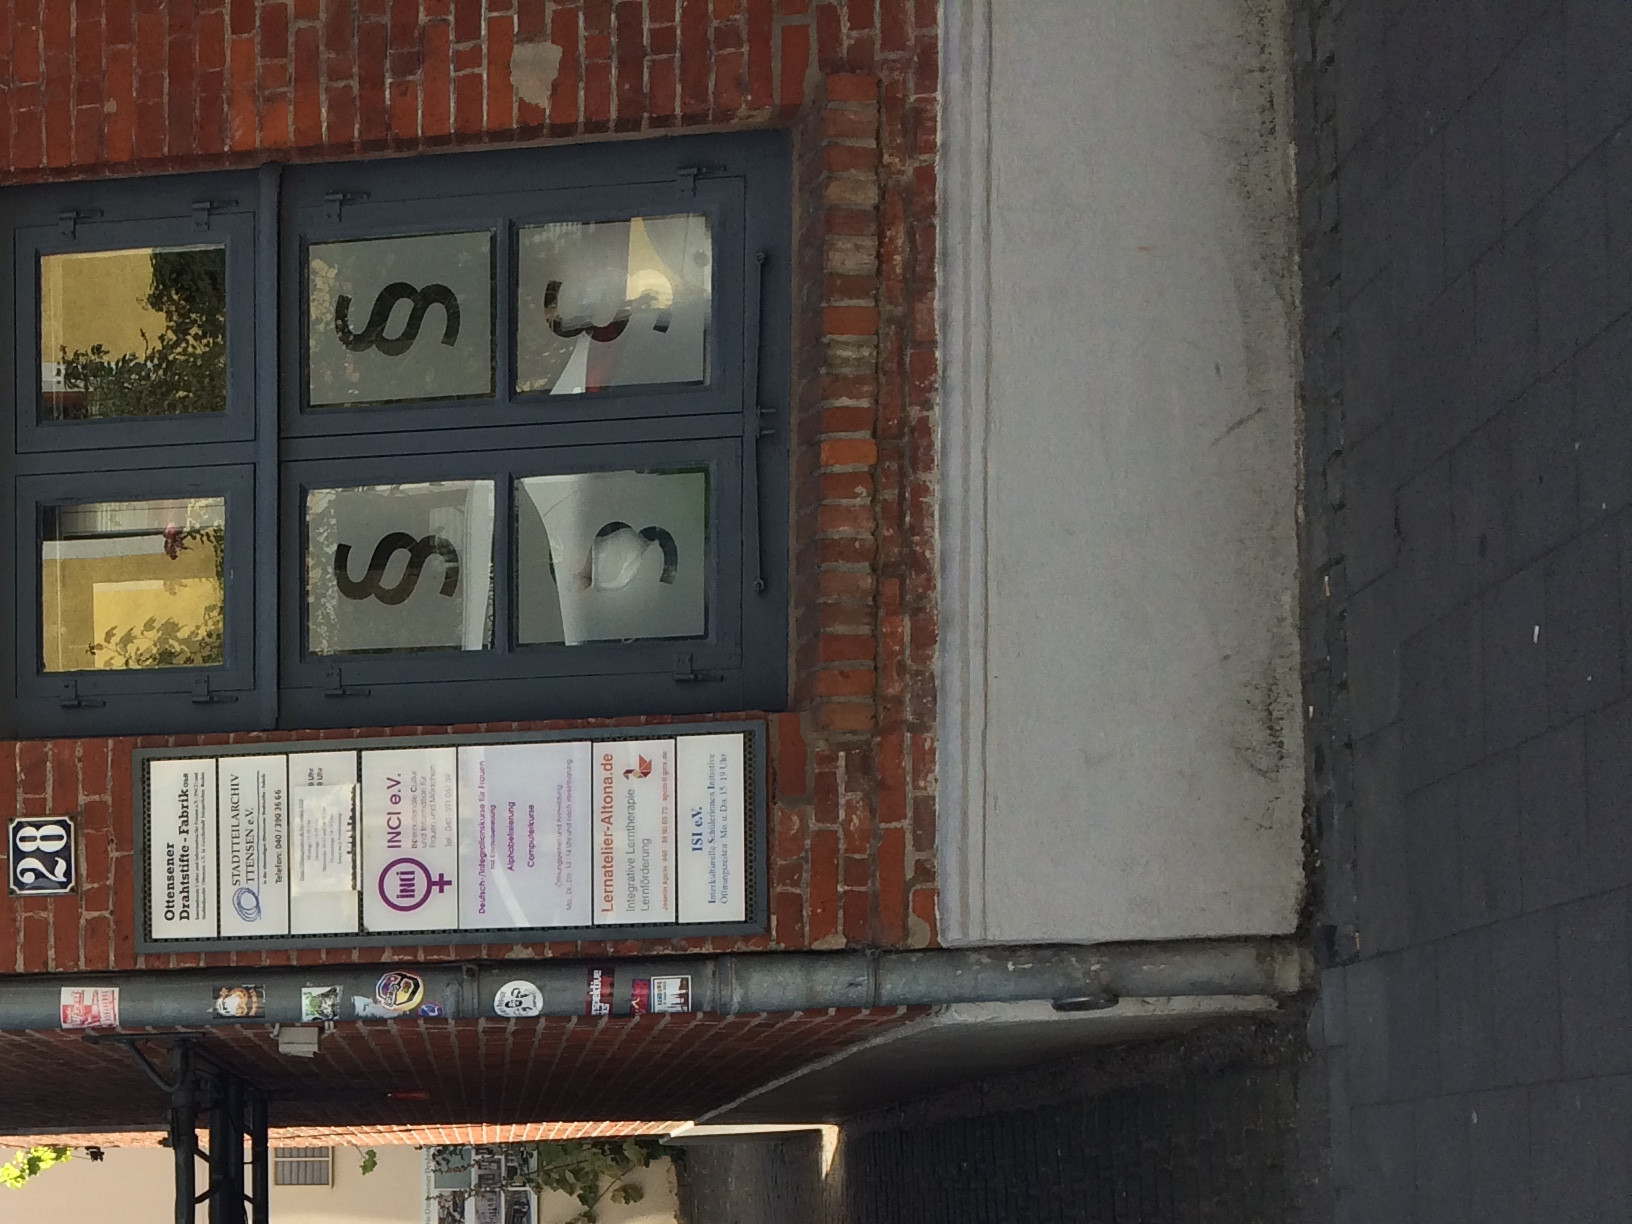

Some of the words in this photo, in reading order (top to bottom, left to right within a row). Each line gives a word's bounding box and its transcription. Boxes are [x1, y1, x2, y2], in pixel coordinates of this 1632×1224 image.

[386, 772, 402, 805] e.V.
[477, 760, 486, 790] Frauen
[178, 788, 190, 836] Fabrik
[230, 773, 241, 887] STADTTEILARCHIV
[245, 807, 255, 826] e.V.
[386, 811, 402, 849] INCI
[505, 801, 517, 872] Alphabetisierung
[526, 804, 537, 868] Computerkurse
[600, 753, 615, 913] Lernatelier-Altona.de
[625, 788, 638, 855] Lerntherapie
[691, 805, 704, 828] e.V.
[15, 824, 67, 884] 28
[274, 834, 282, 850] 040
[274, 851, 283, 885] Telefon:
[691, 831, 704, 852] ISI
[164, 842, 175, 921] Ottensener
[178, 844, 190, 921] Drahtstifte
[625, 857, 638, 912] Integrative
[639, 837, 653, 912] Lernförderung
